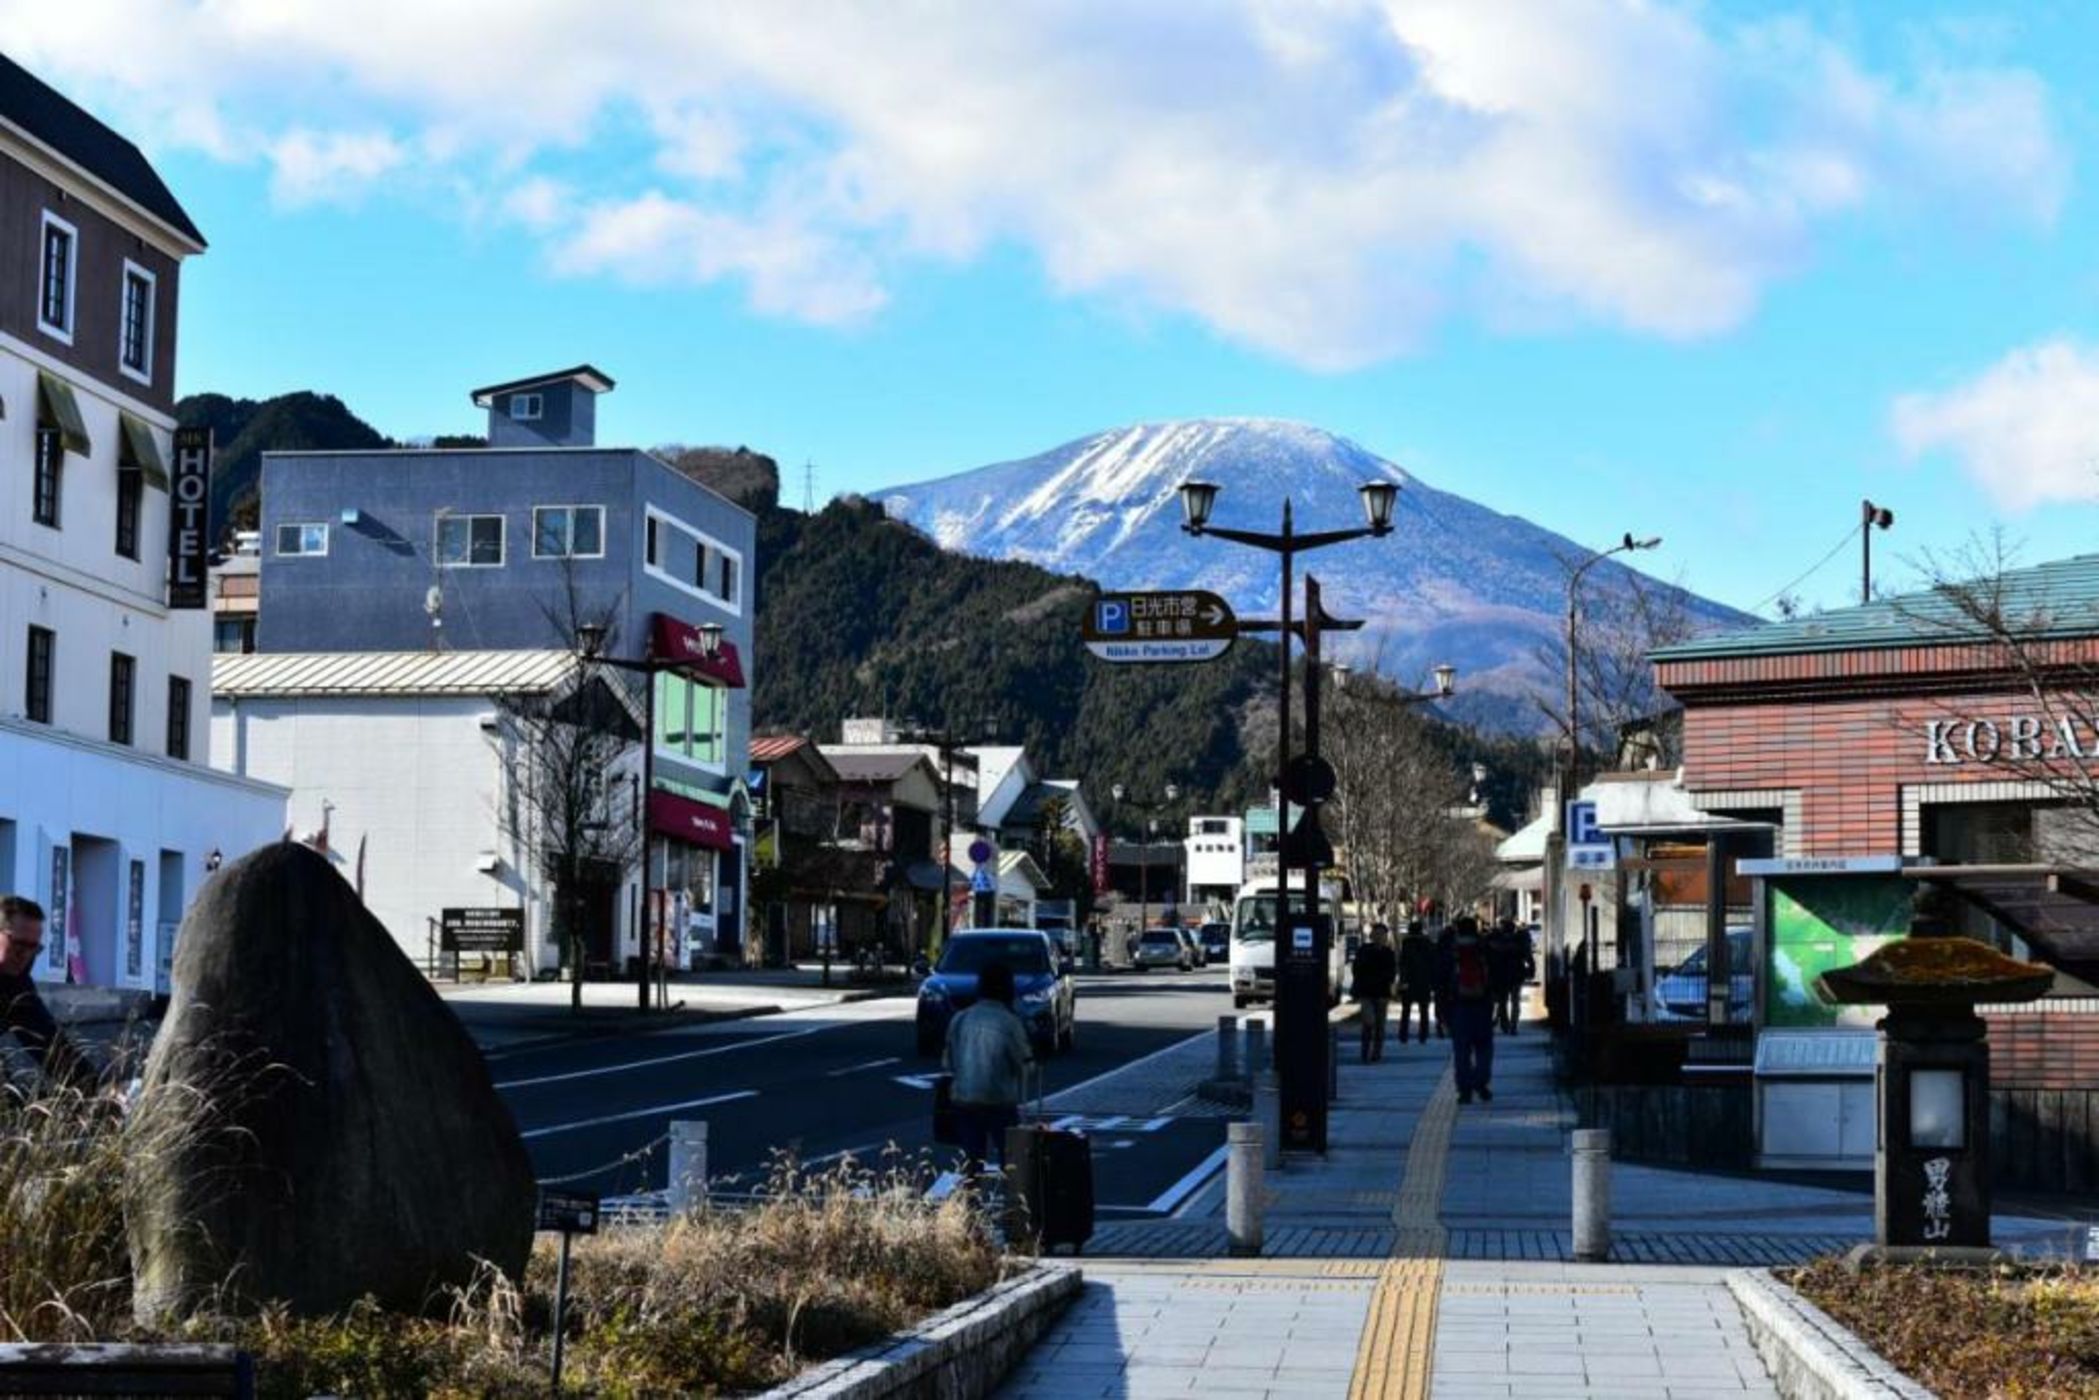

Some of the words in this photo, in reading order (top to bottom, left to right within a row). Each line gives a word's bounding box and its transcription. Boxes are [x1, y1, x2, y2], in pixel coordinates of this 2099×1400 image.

[178, 448, 205, 584] HOTEL
[1102, 604, 1121, 631] P
[1131, 595, 1199, 618] 日光市営
[1106, 645, 1139, 657] Nikko
[1143, 645, 1187, 659] Parking
[1190, 644, 1210, 655] Lot
[1924, 714, 2099, 764] KOBA
